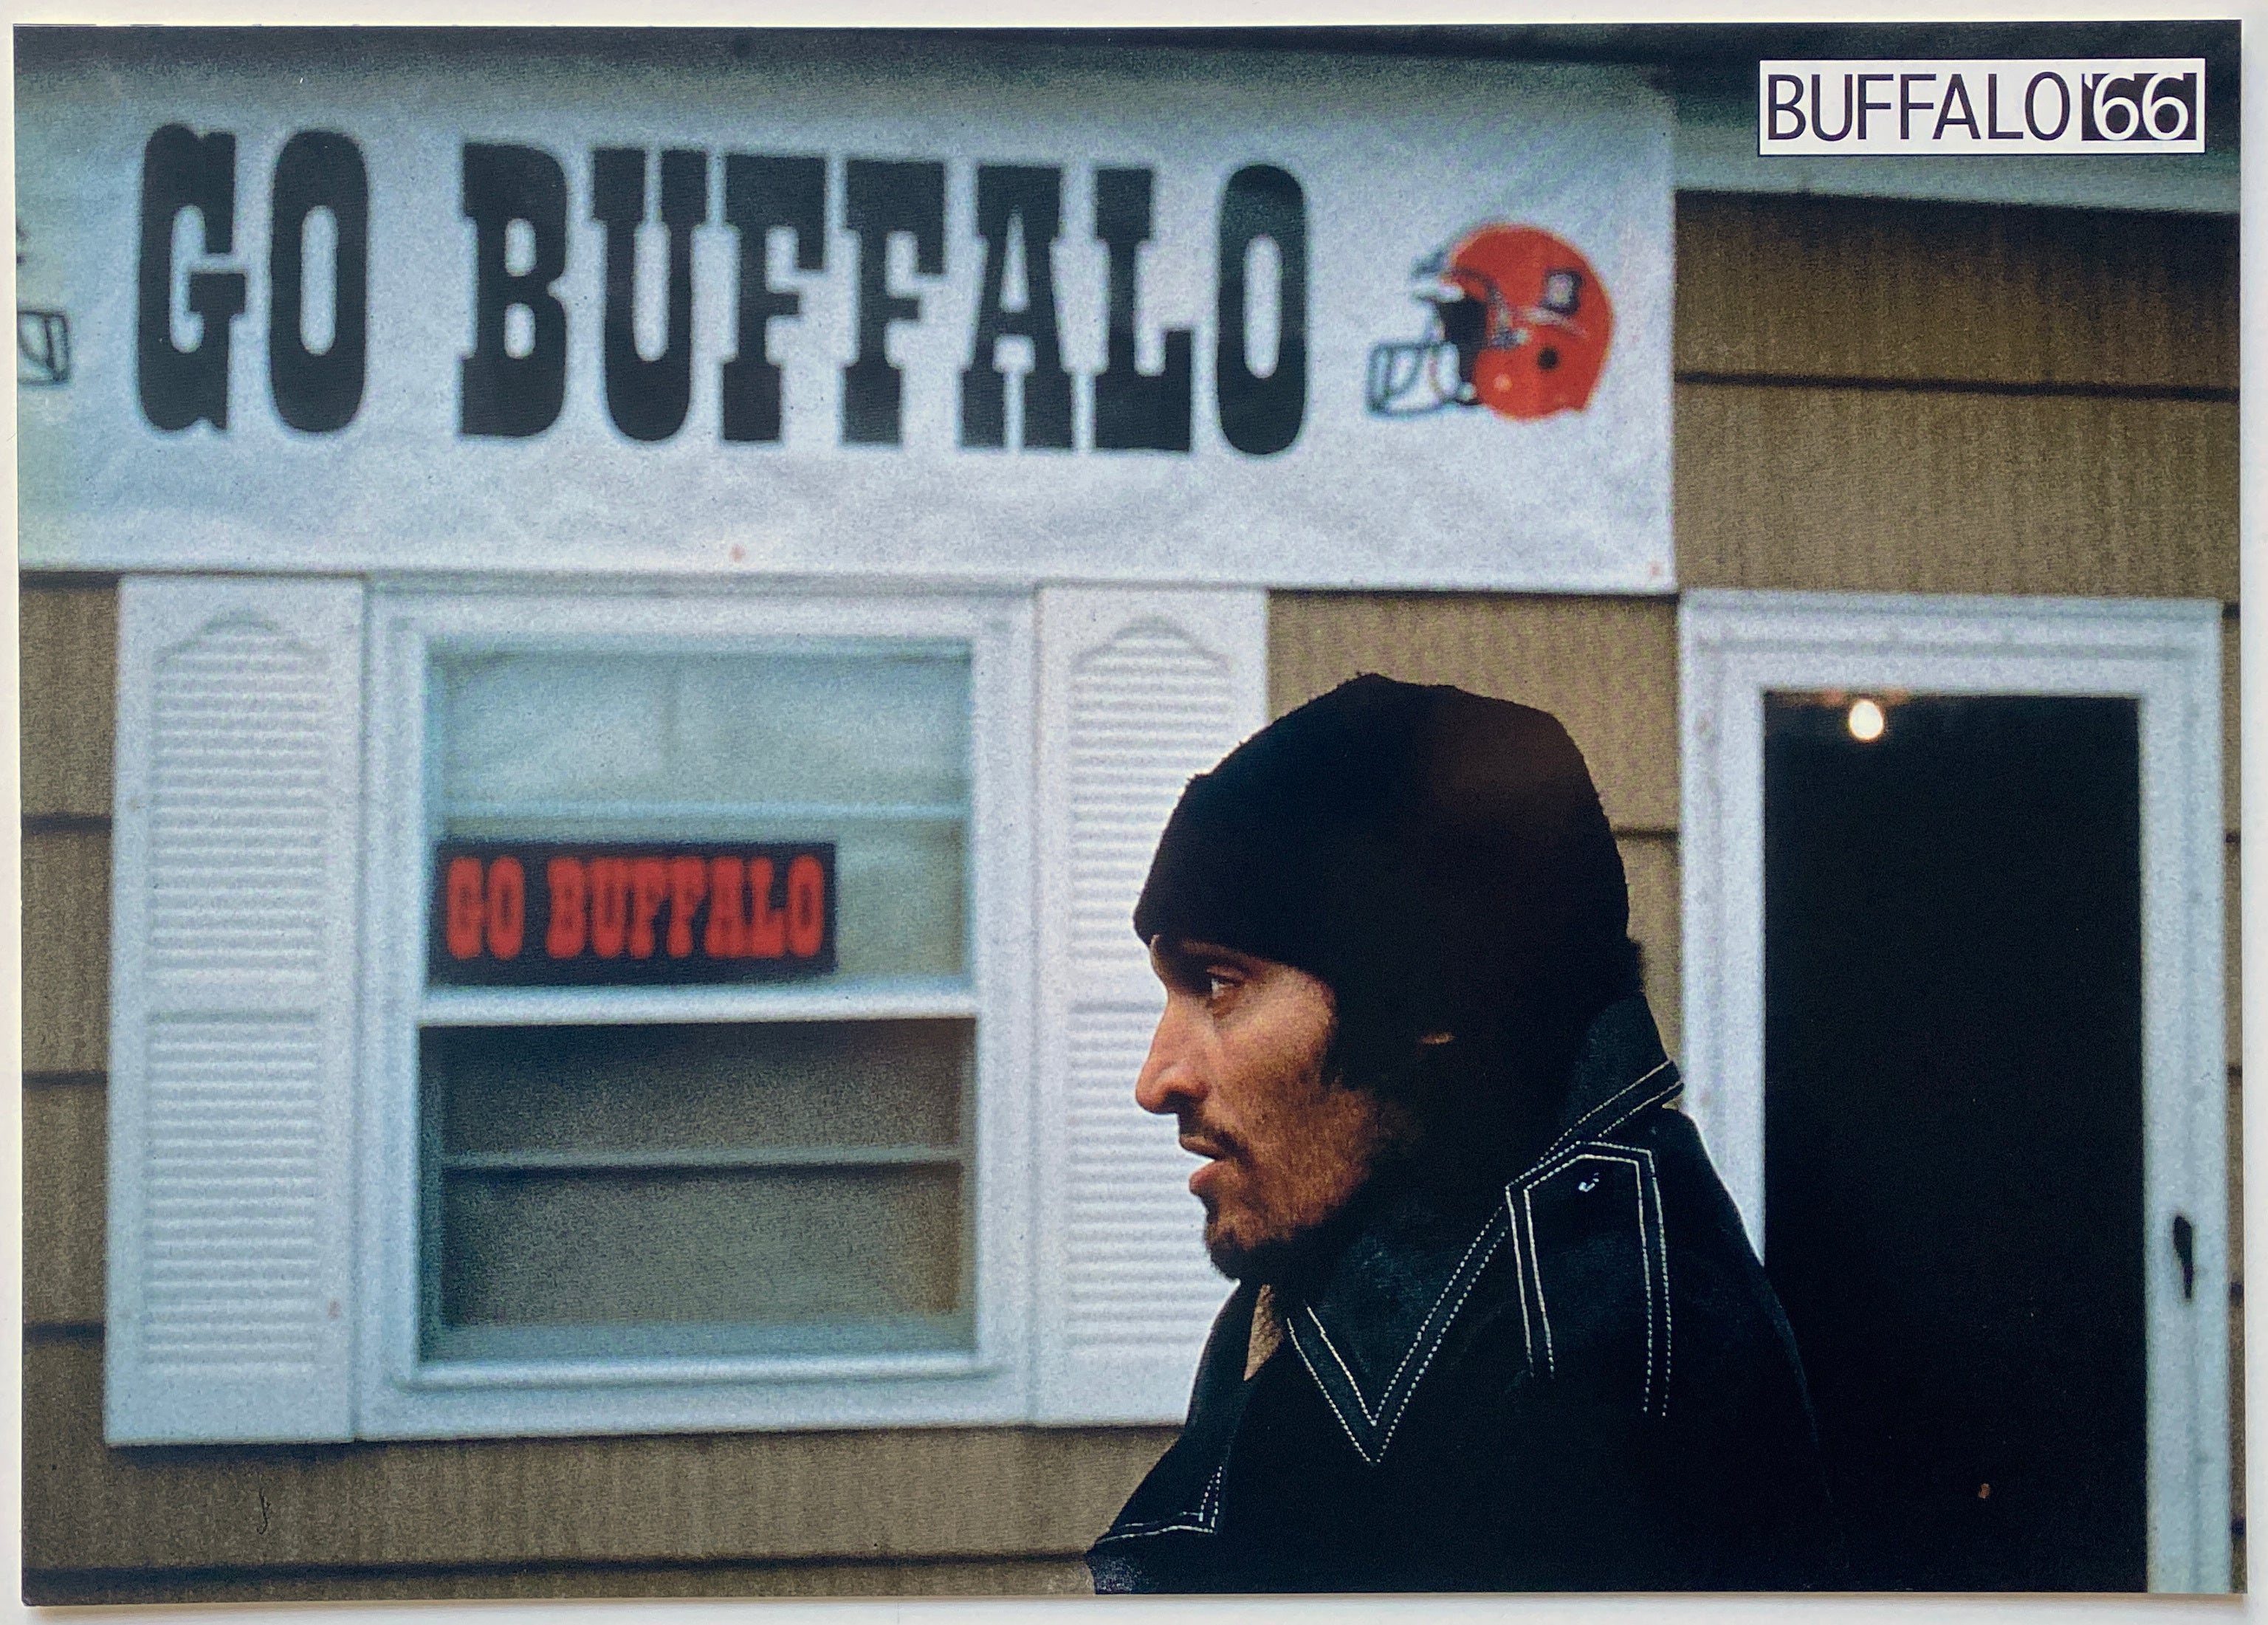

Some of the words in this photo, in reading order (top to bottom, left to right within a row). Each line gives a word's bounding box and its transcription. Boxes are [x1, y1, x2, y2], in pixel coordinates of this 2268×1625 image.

[137, 123, 371, 434] GO
[456, 142, 1307, 456] BUFFALO
[447, 855, 525, 961] GO
[545, 854, 825, 960] BUFFALO
